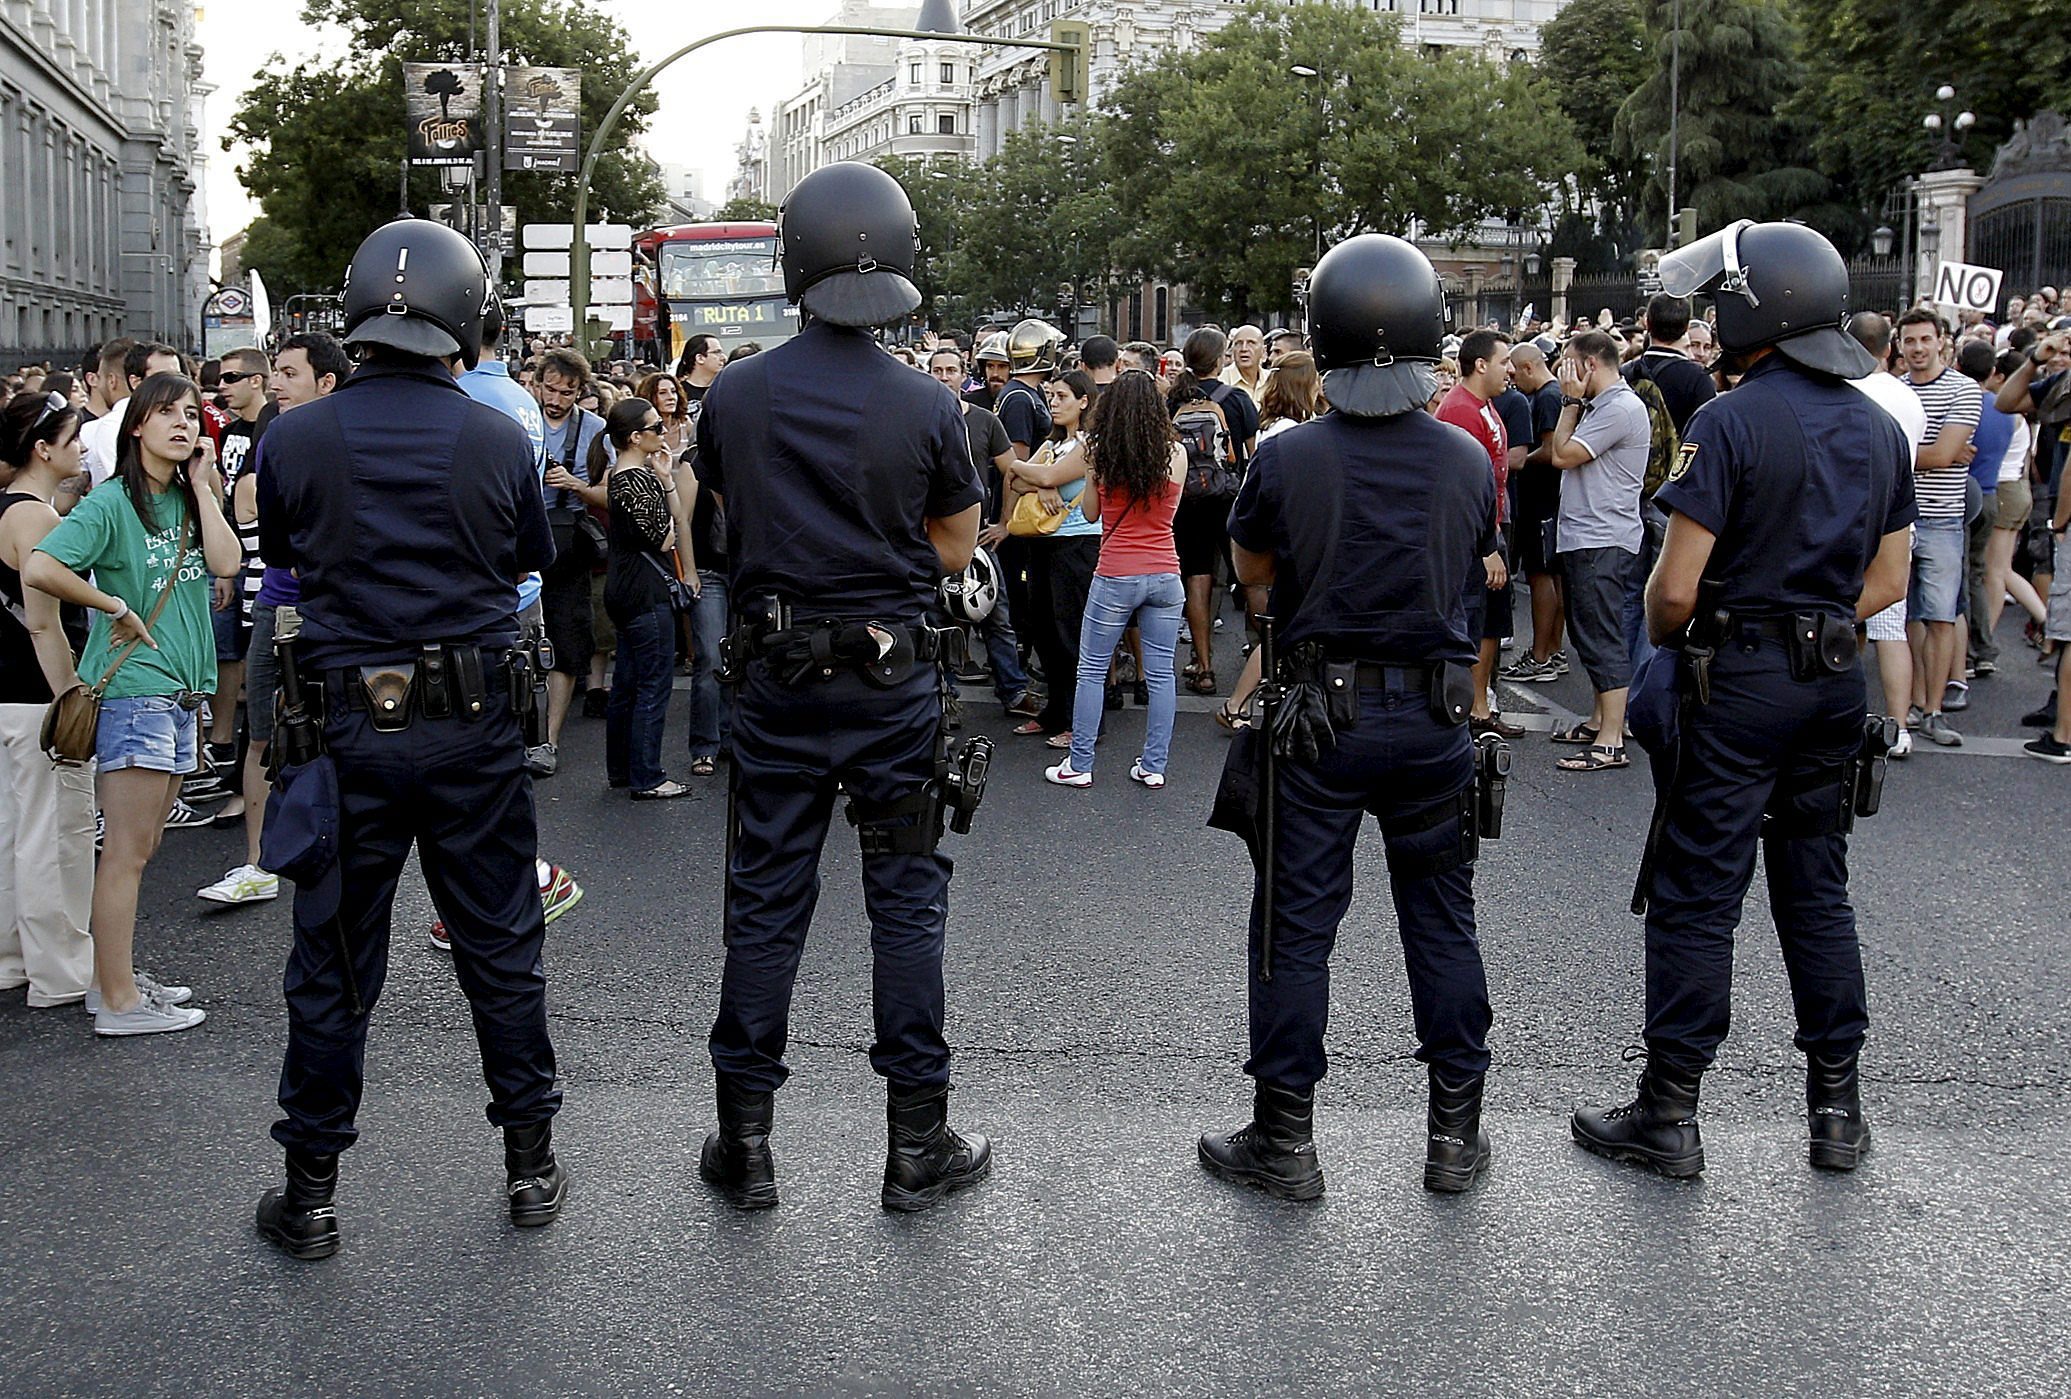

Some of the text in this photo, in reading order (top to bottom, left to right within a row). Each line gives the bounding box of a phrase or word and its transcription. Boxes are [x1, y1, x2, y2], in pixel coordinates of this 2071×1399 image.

[689, 241, 766, 252] madridcitytour.es
[1938, 266, 1996, 309] NO
[703, 304, 764, 324] RUTA 1
